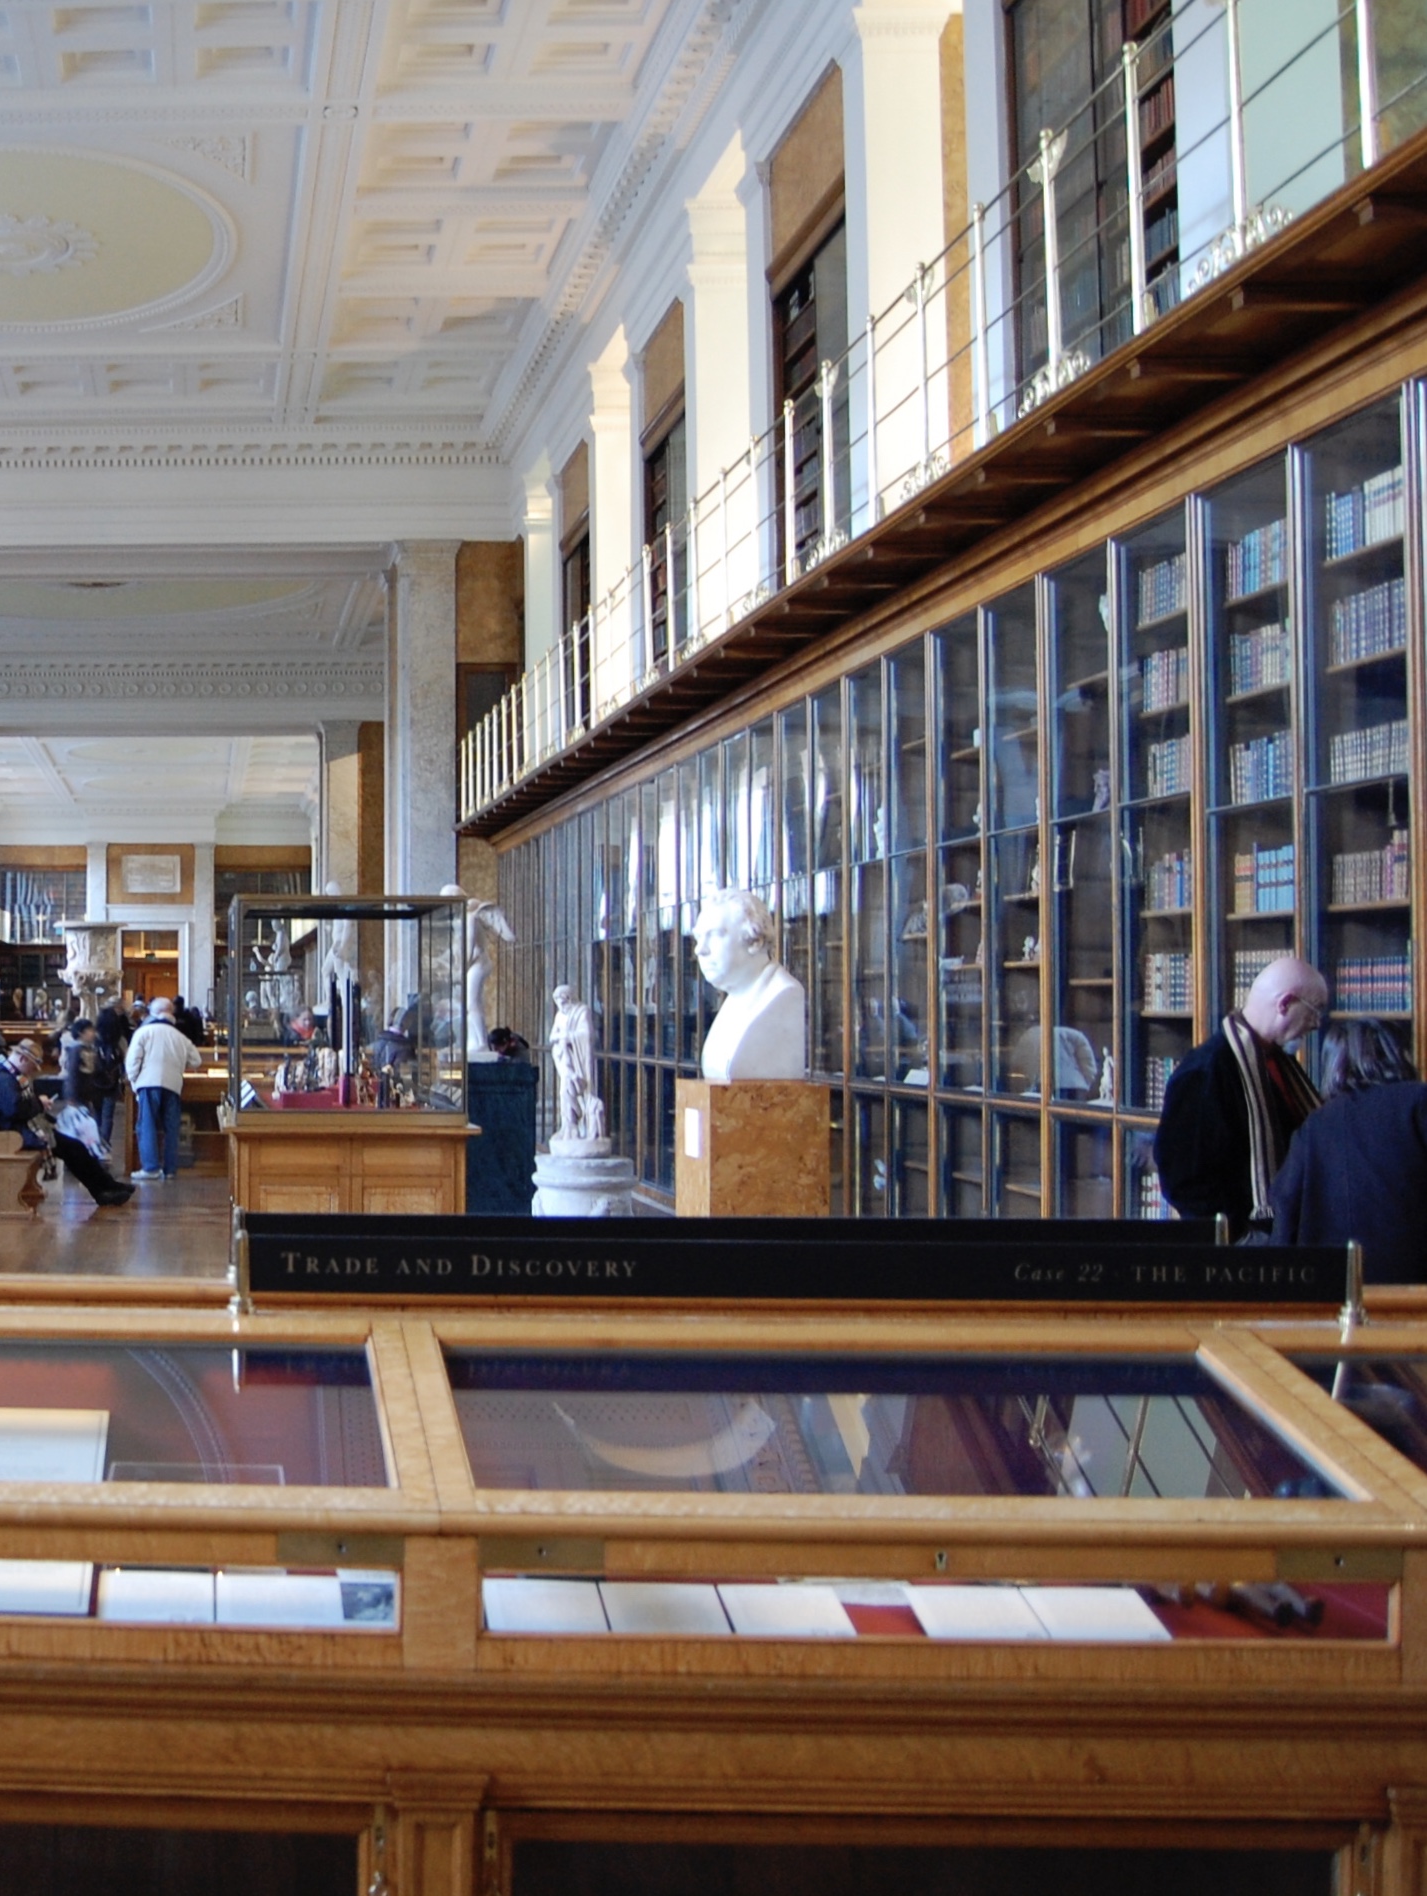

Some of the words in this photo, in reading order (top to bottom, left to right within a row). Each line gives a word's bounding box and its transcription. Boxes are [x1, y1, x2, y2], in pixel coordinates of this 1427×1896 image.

[280, 1252, 379, 1276] TRADE
[396, 1257, 454, 1276] AND
[470, 1254, 638, 1278] DISCOVERY
[1014, 1263, 1066, 1282] Case
[1077, 1263, 1104, 1283] 22
[1130, 1265, 1187, 1284] THE
[1204, 1265, 1316, 1285] PACIFIC
